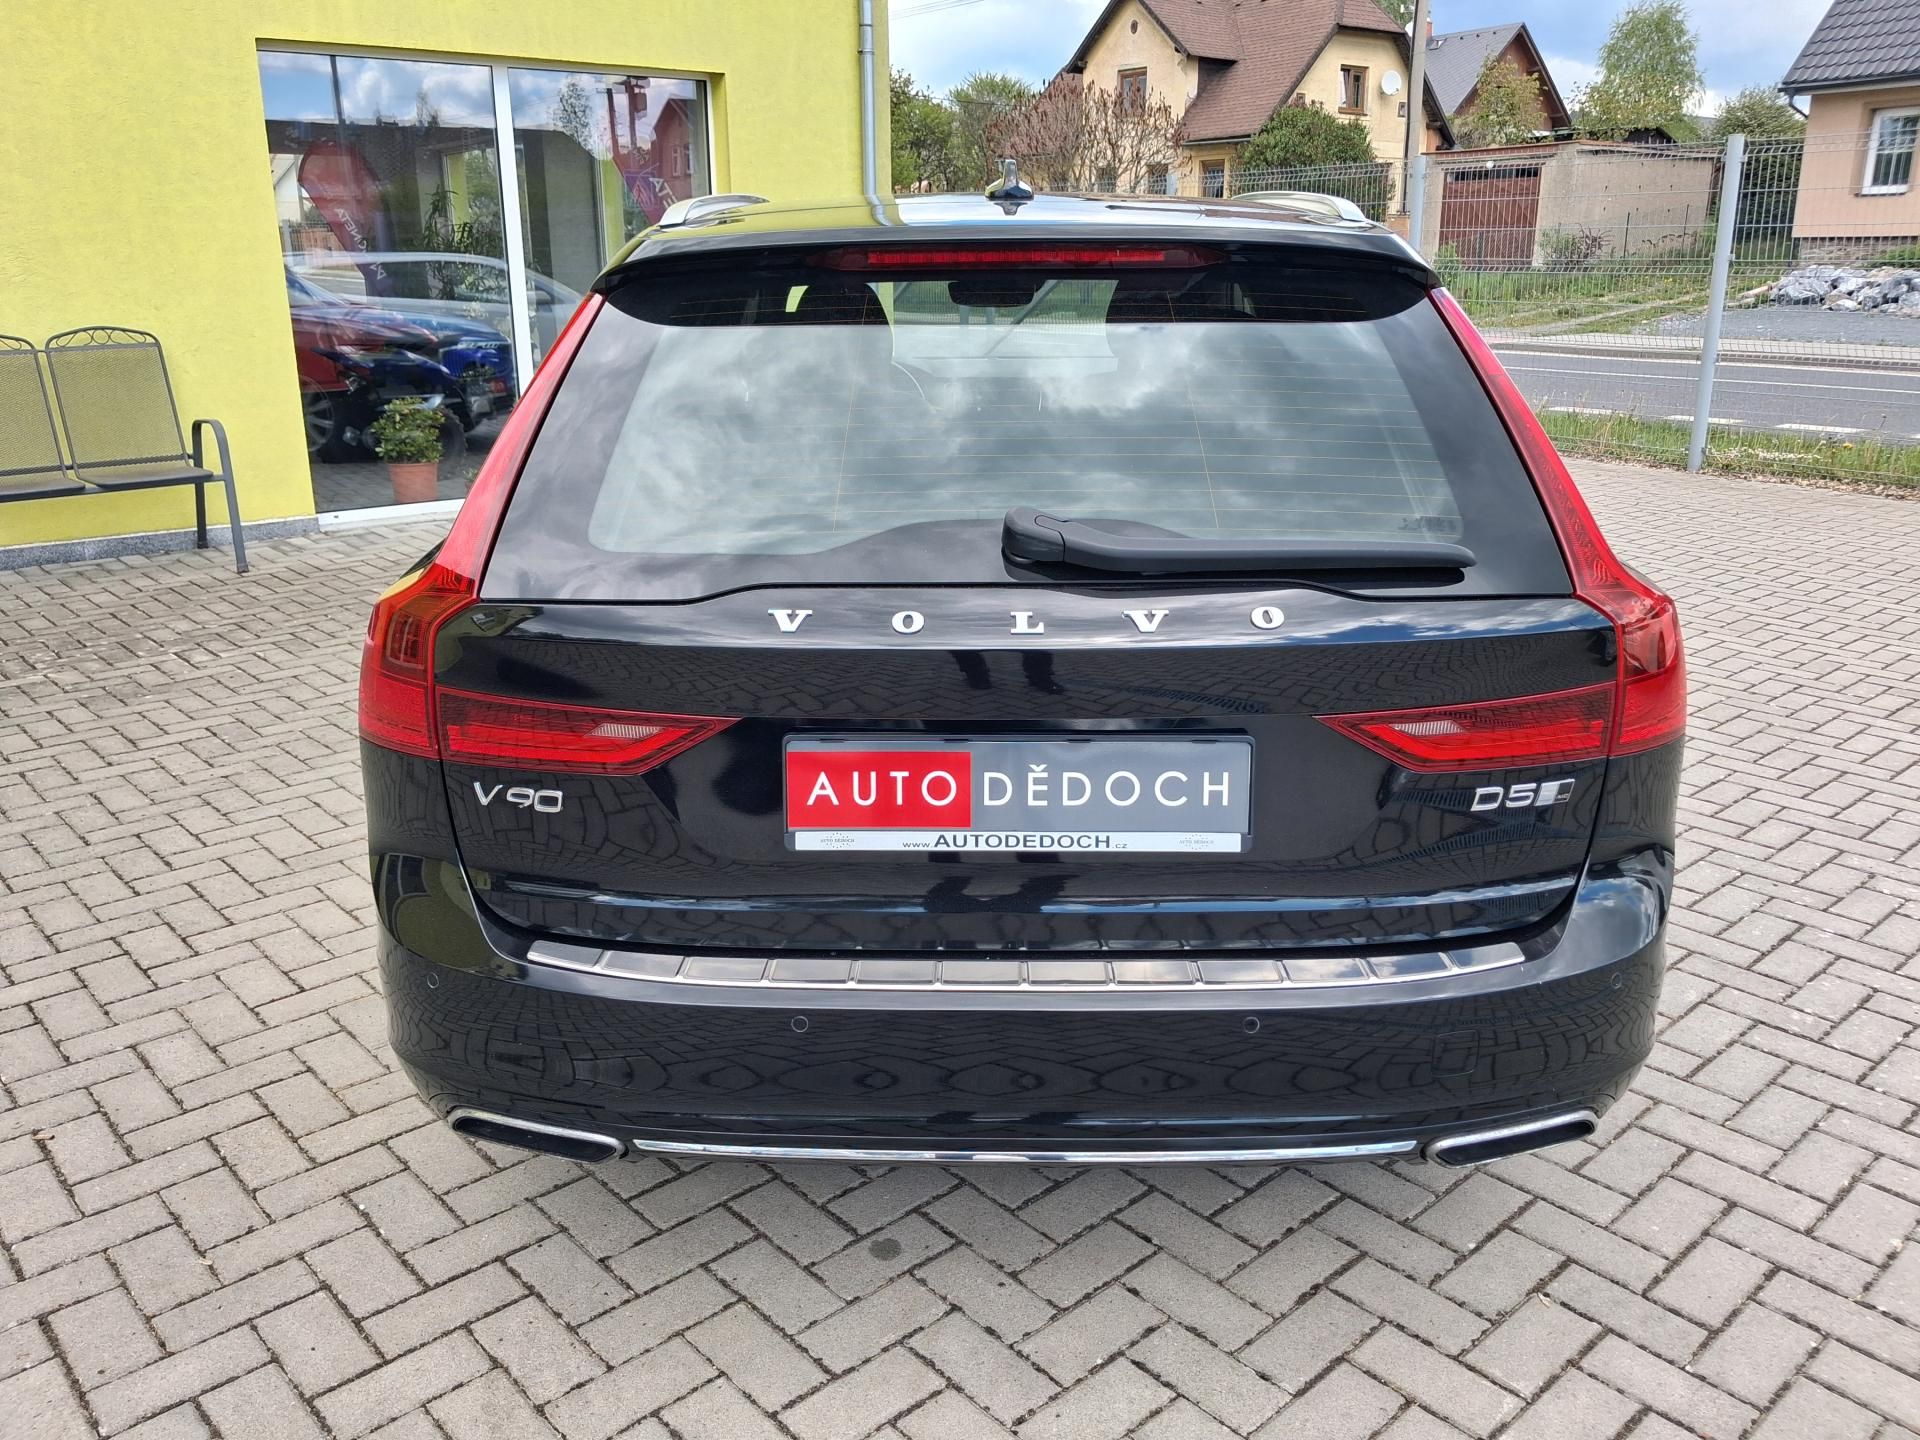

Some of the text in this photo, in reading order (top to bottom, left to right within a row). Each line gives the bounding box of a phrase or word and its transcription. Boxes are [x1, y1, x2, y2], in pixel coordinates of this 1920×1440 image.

[767, 605, 1285, 634] VOLVO
[473, 782, 563, 812] V90
[806, 764, 1230, 807] AUTO DĚDOCH
[1470, 783, 1537, 811] D5
[902, 834, 1128, 849] www.AUTODEDOCH.cz
